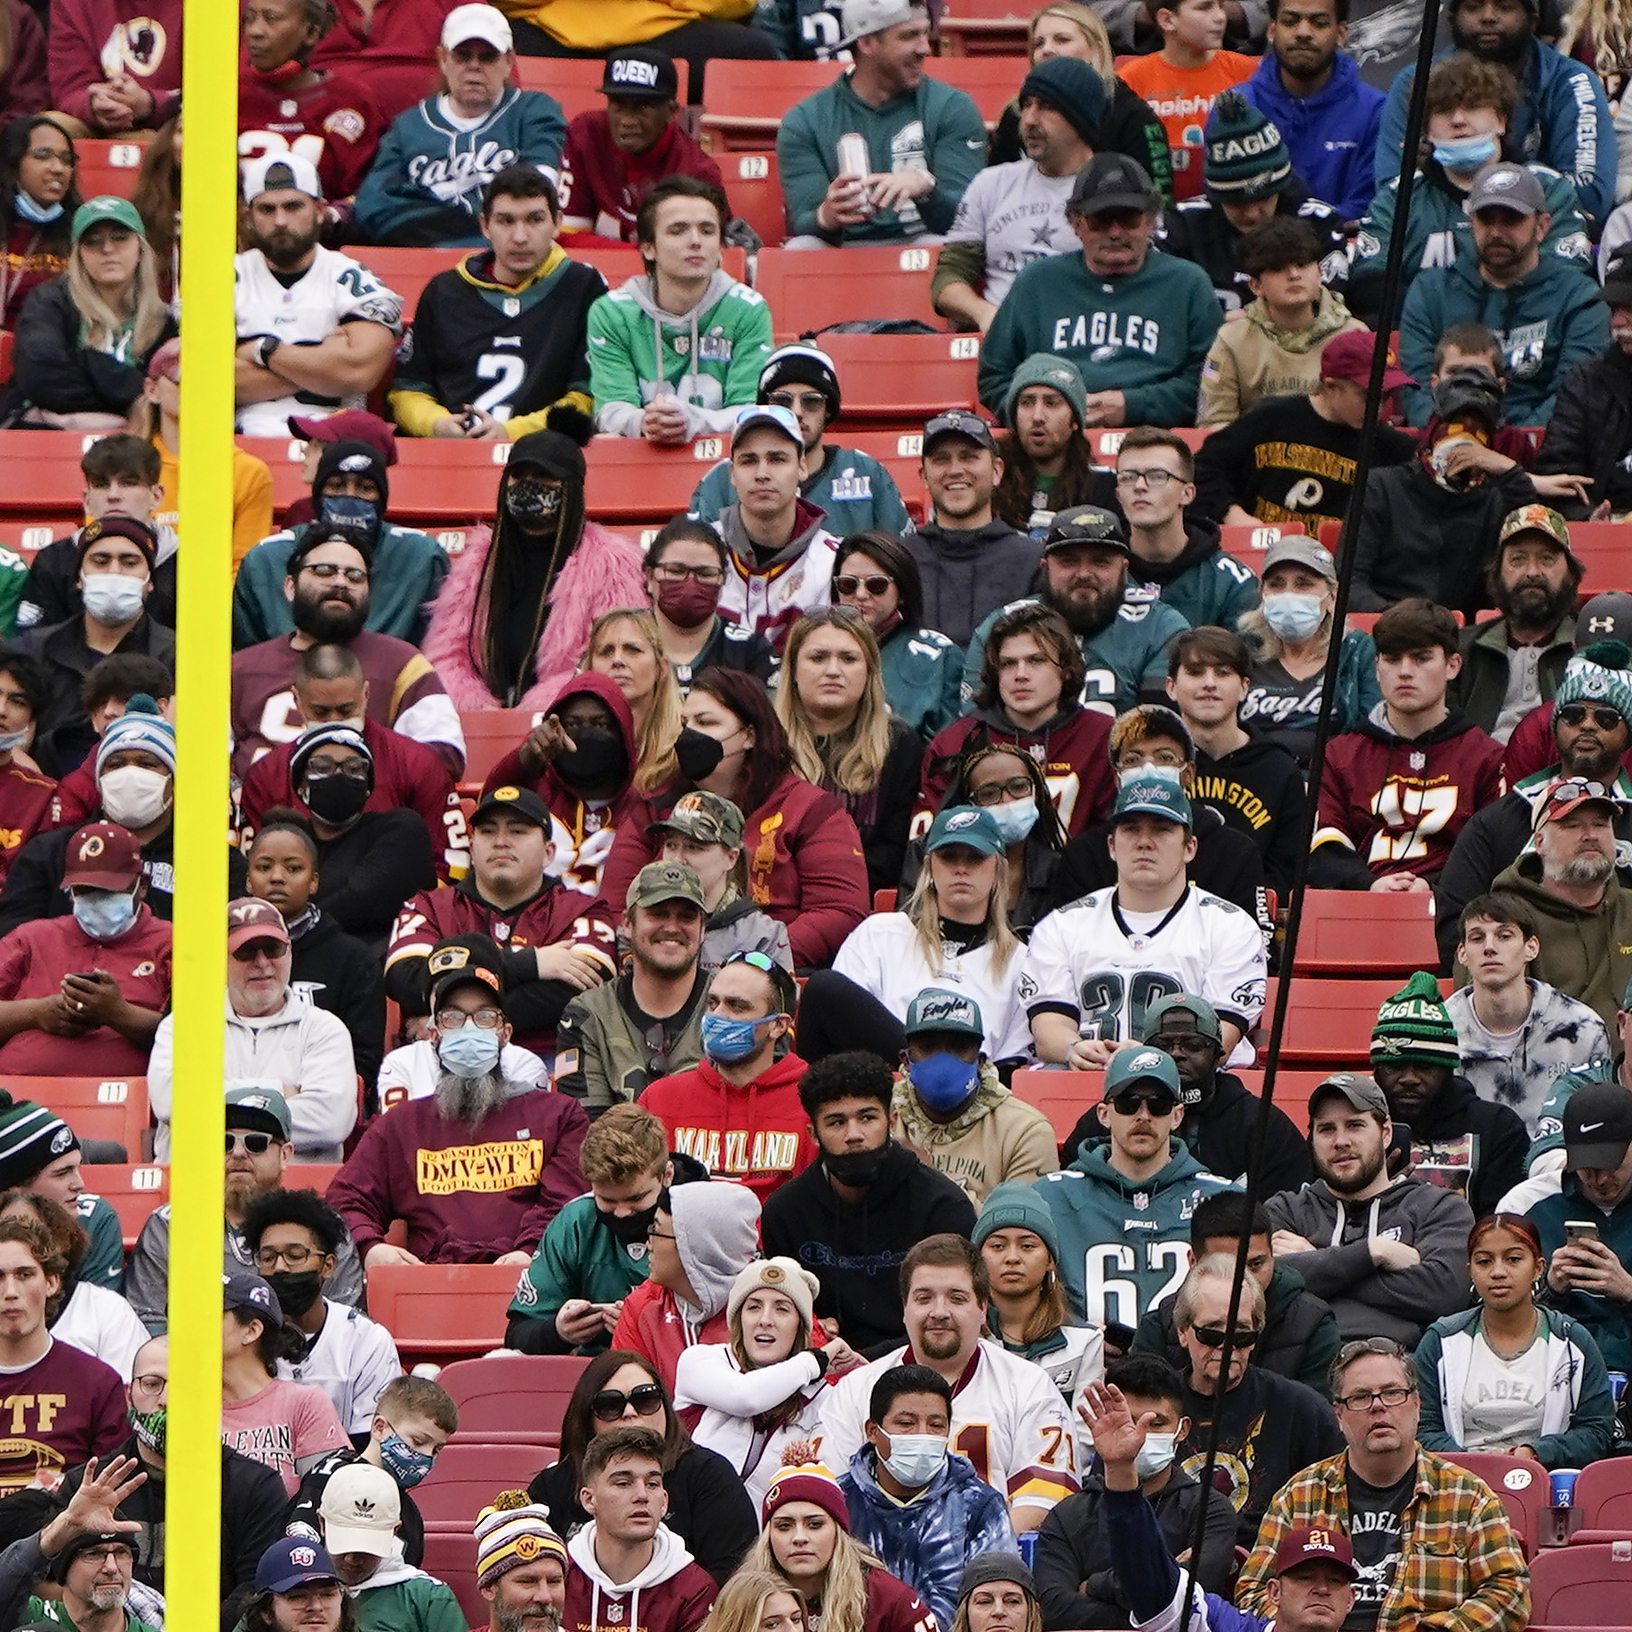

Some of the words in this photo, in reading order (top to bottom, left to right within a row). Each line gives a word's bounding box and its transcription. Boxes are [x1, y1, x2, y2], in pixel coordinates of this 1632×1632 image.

[612, 60, 658, 86] QUEEN
[1054, 315, 1160, 353] EAGLES
[957, 340, 974, 357] 14
[476, 356, 524, 422] 2
[701, 440, 720, 458] 13
[1368, 783, 1458, 859] 17
[1376, 1001, 1446, 1026] EAGLES
[674, 1124, 798, 1172] MARYLAND
[141, 1170, 156, 1187] 11
[1083, 1242, 1191, 1322] 62
[1038, 1426, 1077, 1471] 71
[1508, 1473, 1526, 1488] 17
[353, 1510, 373, 1519] adidas
[1302, 1542, 1336, 1555] TAYLOR
[1308, 1529, 1329, 1545] 21
